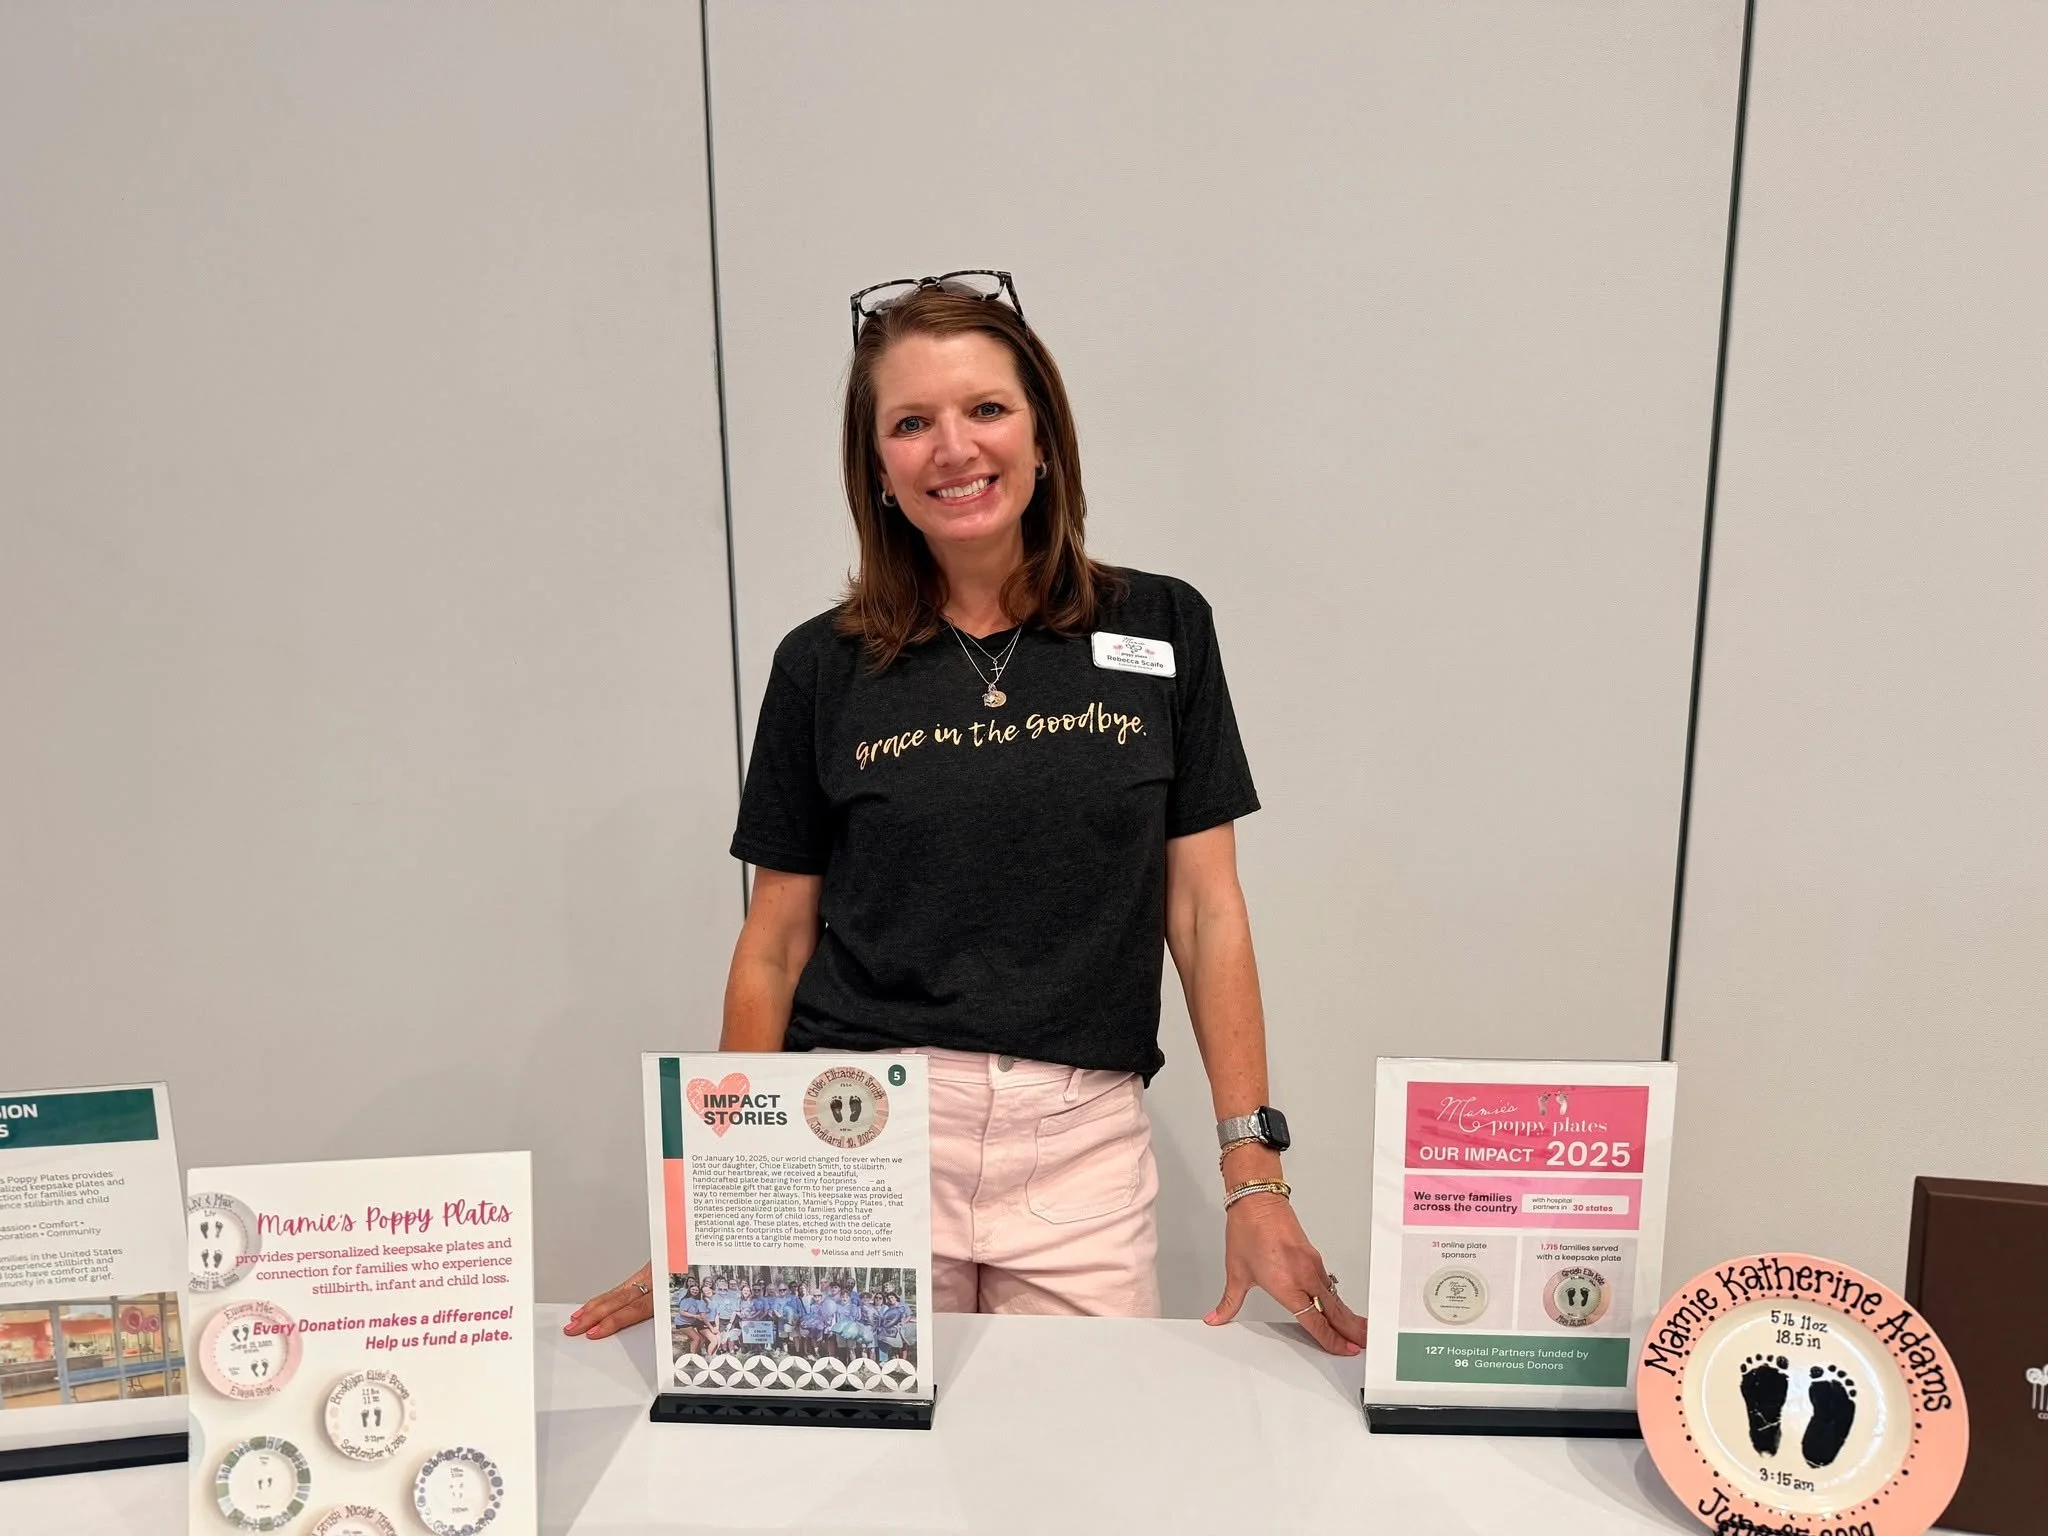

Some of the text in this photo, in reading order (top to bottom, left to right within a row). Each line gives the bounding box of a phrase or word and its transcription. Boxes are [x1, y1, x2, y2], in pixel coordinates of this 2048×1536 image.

[1107, 655, 1140, 665] Rebecca
[855, 728, 927, 770] grace
[934, 723, 964, 746] in
[968, 719, 1020, 747] the
[894, 1071, 901, 1081] 5
[808, 1069, 884, 1101] Chloe Elizabeth Smith
[703, 1094, 781, 1109] IMPACT
[0, 1104, 38, 1120] ION
[703, 1111, 788, 1126] STORIES
[1490, 1119, 1546, 1137] poppy
[1552, 1116, 1608, 1133] plates
[692, 1154, 703, 1162] On
[705, 1154, 734, 1163] January
[808, 1156, 840, 1164] changed
[1419, 1140, 1631, 1167] OUR IMPACT 2025
[722, 1162, 758, 1170] daughter,
[7, 1176, 38, 1185] Poppy
[40, 1173, 69, 1182] Plates
[72, 1170, 113, 1181] provides
[29, 1182, 74, 1192] keepsake
[75, 1179, 104, 1189] plates
[106, 1177, 125, 1186] and
[24, 1191, 38, 1199] for
[40, 1189, 78, 1198] families
[79, 1187, 100, 1196] who
[1413, 1191, 1513, 1203] We serve families
[23, 1199, 64, 1208] stillbirth
[66, 1197, 84, 1205] and
[86, 1195, 110, 1204] child
[1532, 1203, 1559, 1212] partners
[1546, 1197, 1573, 1205] hospital
[1413, 1202, 1518, 1215] across the country
[1572, 1204, 1614, 1213] 30 states
[256, 1198, 513, 1238] Mamie's Poppy Plates
[39, 1220, 79, 1230] Comfort
[46, 1228, 101, 1238] Community
[235, 1237, 512, 1267] provides personalized keepsake plates and
[865, 1249, 881, 1257] Jeff
[882, 1249, 904, 1257] Smith
[1431, 1241, 1488, 1252] 31 online plate
[1559, 1243, 1591, 1253] families
[1591, 1244, 1619, 1253] served
[41, 1252, 58, 1260] the
[59, 1249, 91, 1259] United
[93, 1247, 123, 1256] States
[1441, 1251, 1477, 1261] sponsors
[1536, 1253, 1553, 1262] with
[1561, 1253, 1599, 1264] keepsake
[1600, 1254, 1622, 1265] plate
[54, 1258, 94, 1268] stillbirth
[96, 1256, 114, 1264] and
[256, 1255, 512, 1281] connection for families who experience
[4, 1265, 109, 1280] loss have comfort and
[54, 1275, 77, 1284] time
[78, 1274, 88, 1282] of
[90, 1272, 114, 1283] grief.
[311, 1272, 510, 1296] stillbirth, infant and child loss.
[252, 1306, 514, 1338] Every Donation makes a difference!
[1770, 1310, 1781, 1324] 5
[1782, 1311, 1795, 1327] lb
[365, 1328, 513, 1351] Help us fund a plate.
[1645, 1257, 1952, 1414] Mamie Katherine Adams
[1776, 1329, 1821, 1350] 18.5 in
[1425, 1346, 1589, 1360] 127 Hospital Partners funded by
[1454, 1359, 1564, 1370] 96 Generous Donors
